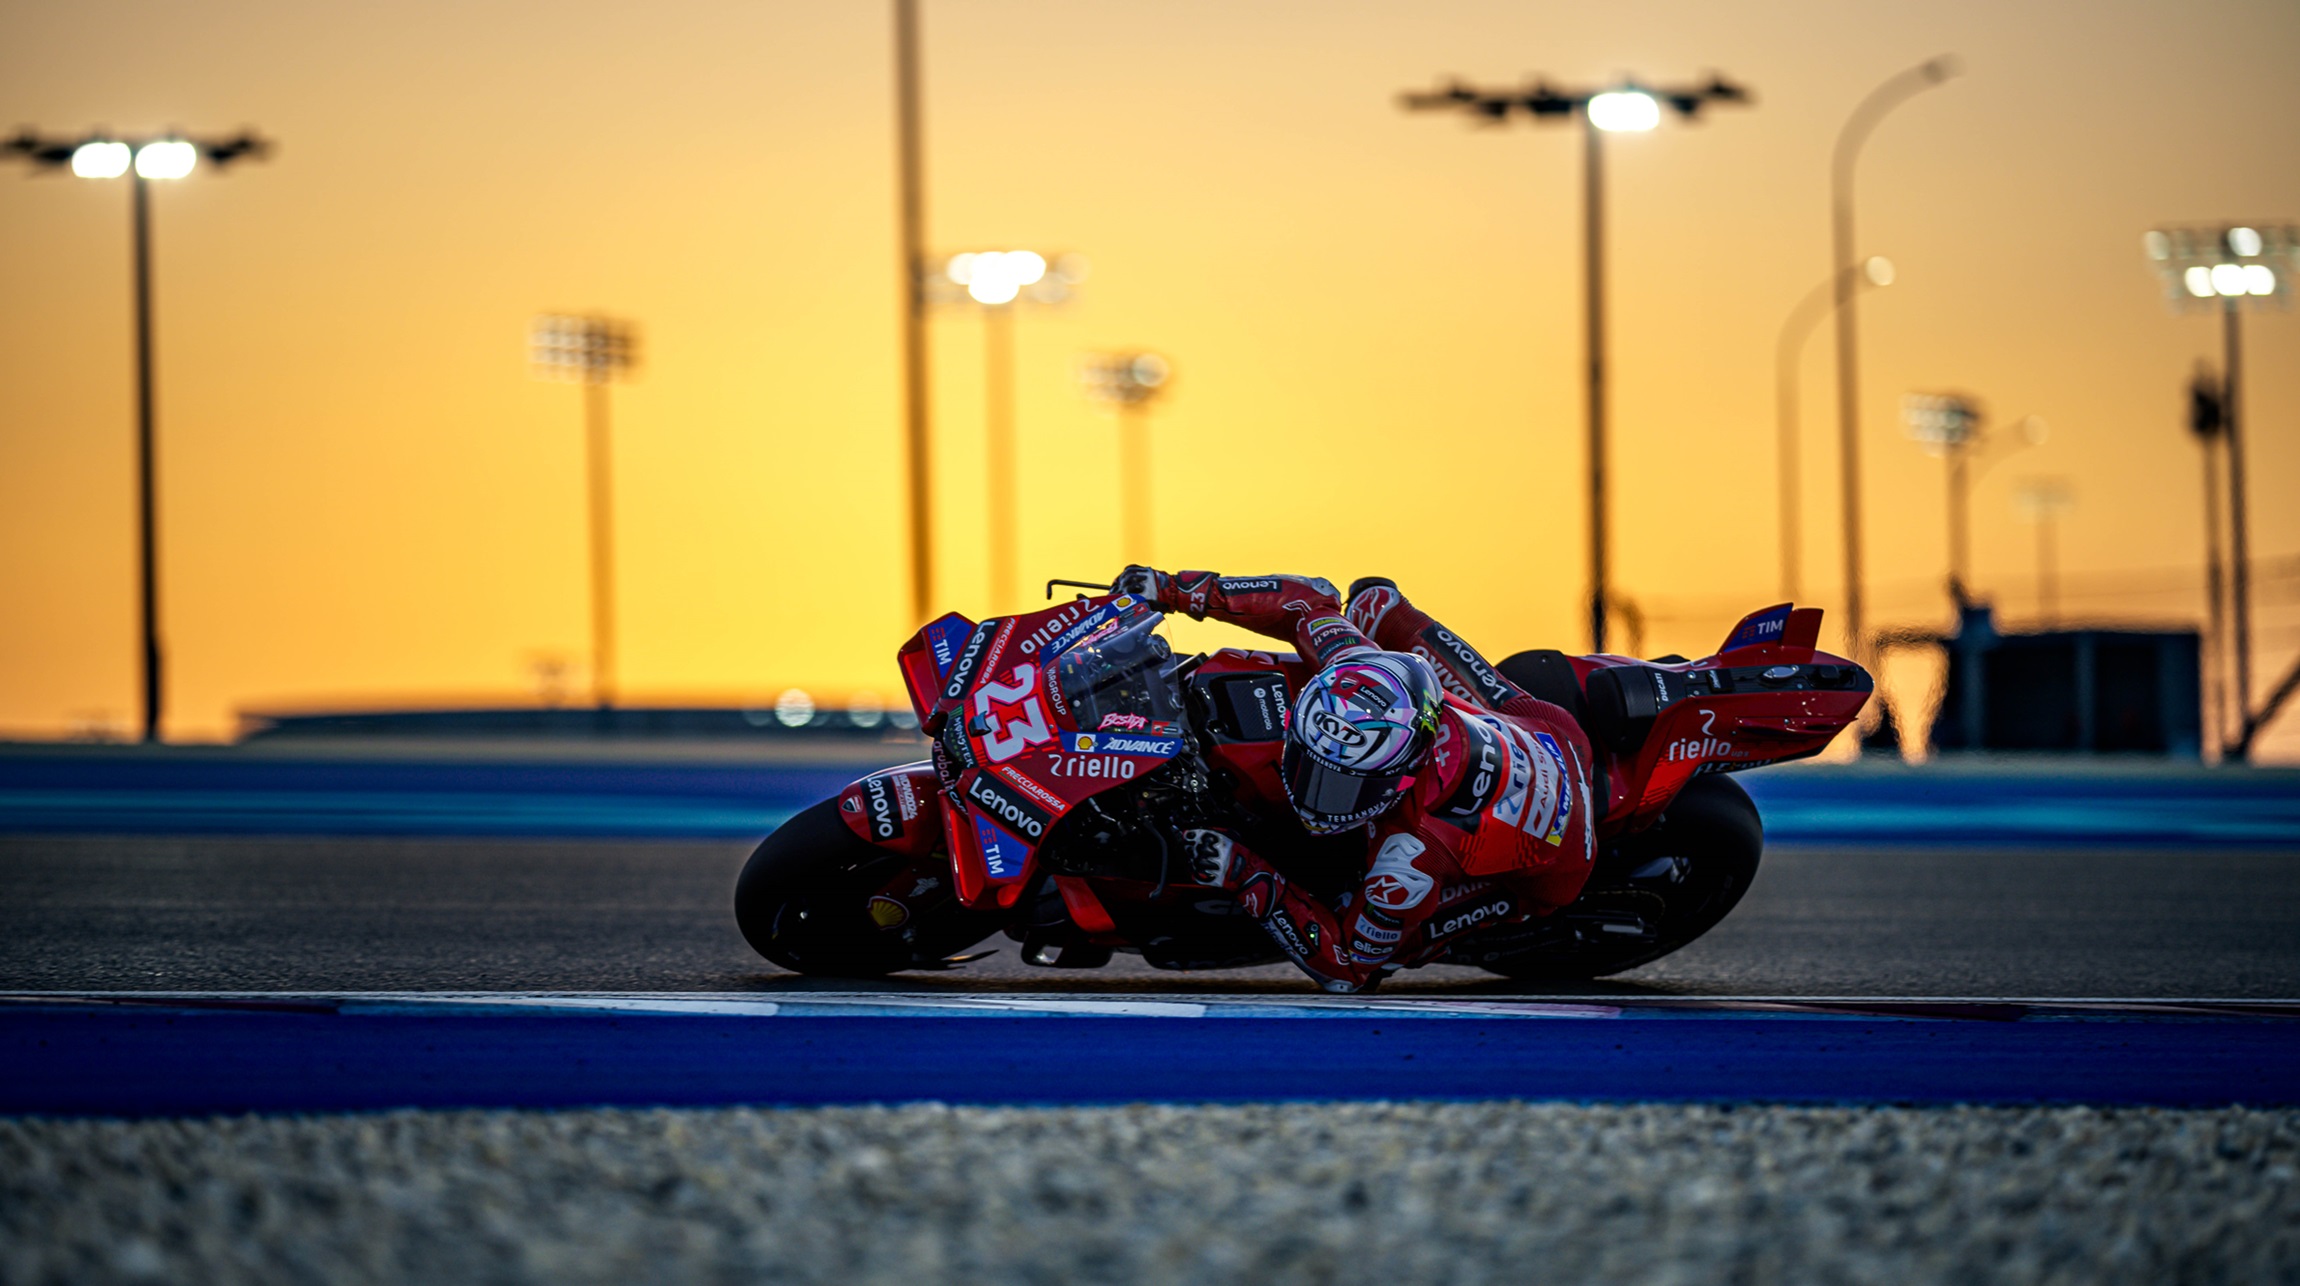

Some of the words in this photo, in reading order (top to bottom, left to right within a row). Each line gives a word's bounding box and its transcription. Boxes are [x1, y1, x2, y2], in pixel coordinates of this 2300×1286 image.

[1222, 580, 1278, 590] Lenovo
[1020, 605, 1081, 655] riello
[1052, 608, 1107, 654] ADVANCE
[1757, 619, 1784, 635] TIM
[934, 639, 953, 666] TIM
[948, 620, 996, 698] Lenovo
[1437, 630, 1508, 701] Lenovo
[1360, 685, 1388, 708] Lenovo
[1654, 672, 1669, 702] DUCATI
[973, 661, 1052, 763] 23
[953, 716, 975, 768] MONSTER
[1315, 713, 1361, 742] KYT
[1102, 738, 1174, 755] ADVANCE
[1306, 749, 1341, 772] TERRANOVA
[1668, 737, 1732, 762] riello
[1066, 755, 1136, 779] riello
[1450, 724, 1496, 816] Leno
[1001, 766, 1066, 811] FRECCIAROSSA
[867, 775, 894, 838] Lenovo
[969, 776, 1042, 837] Lenovo
[1327, 801, 1386, 823] TERRANOVA
[985, 844, 1005, 874] TIM
[1272, 909, 1309, 955] Lenovo
[1366, 925, 1399, 941] riello
[1429, 900, 1510, 940] Lenovo
[1353, 940, 1394, 955] elica
